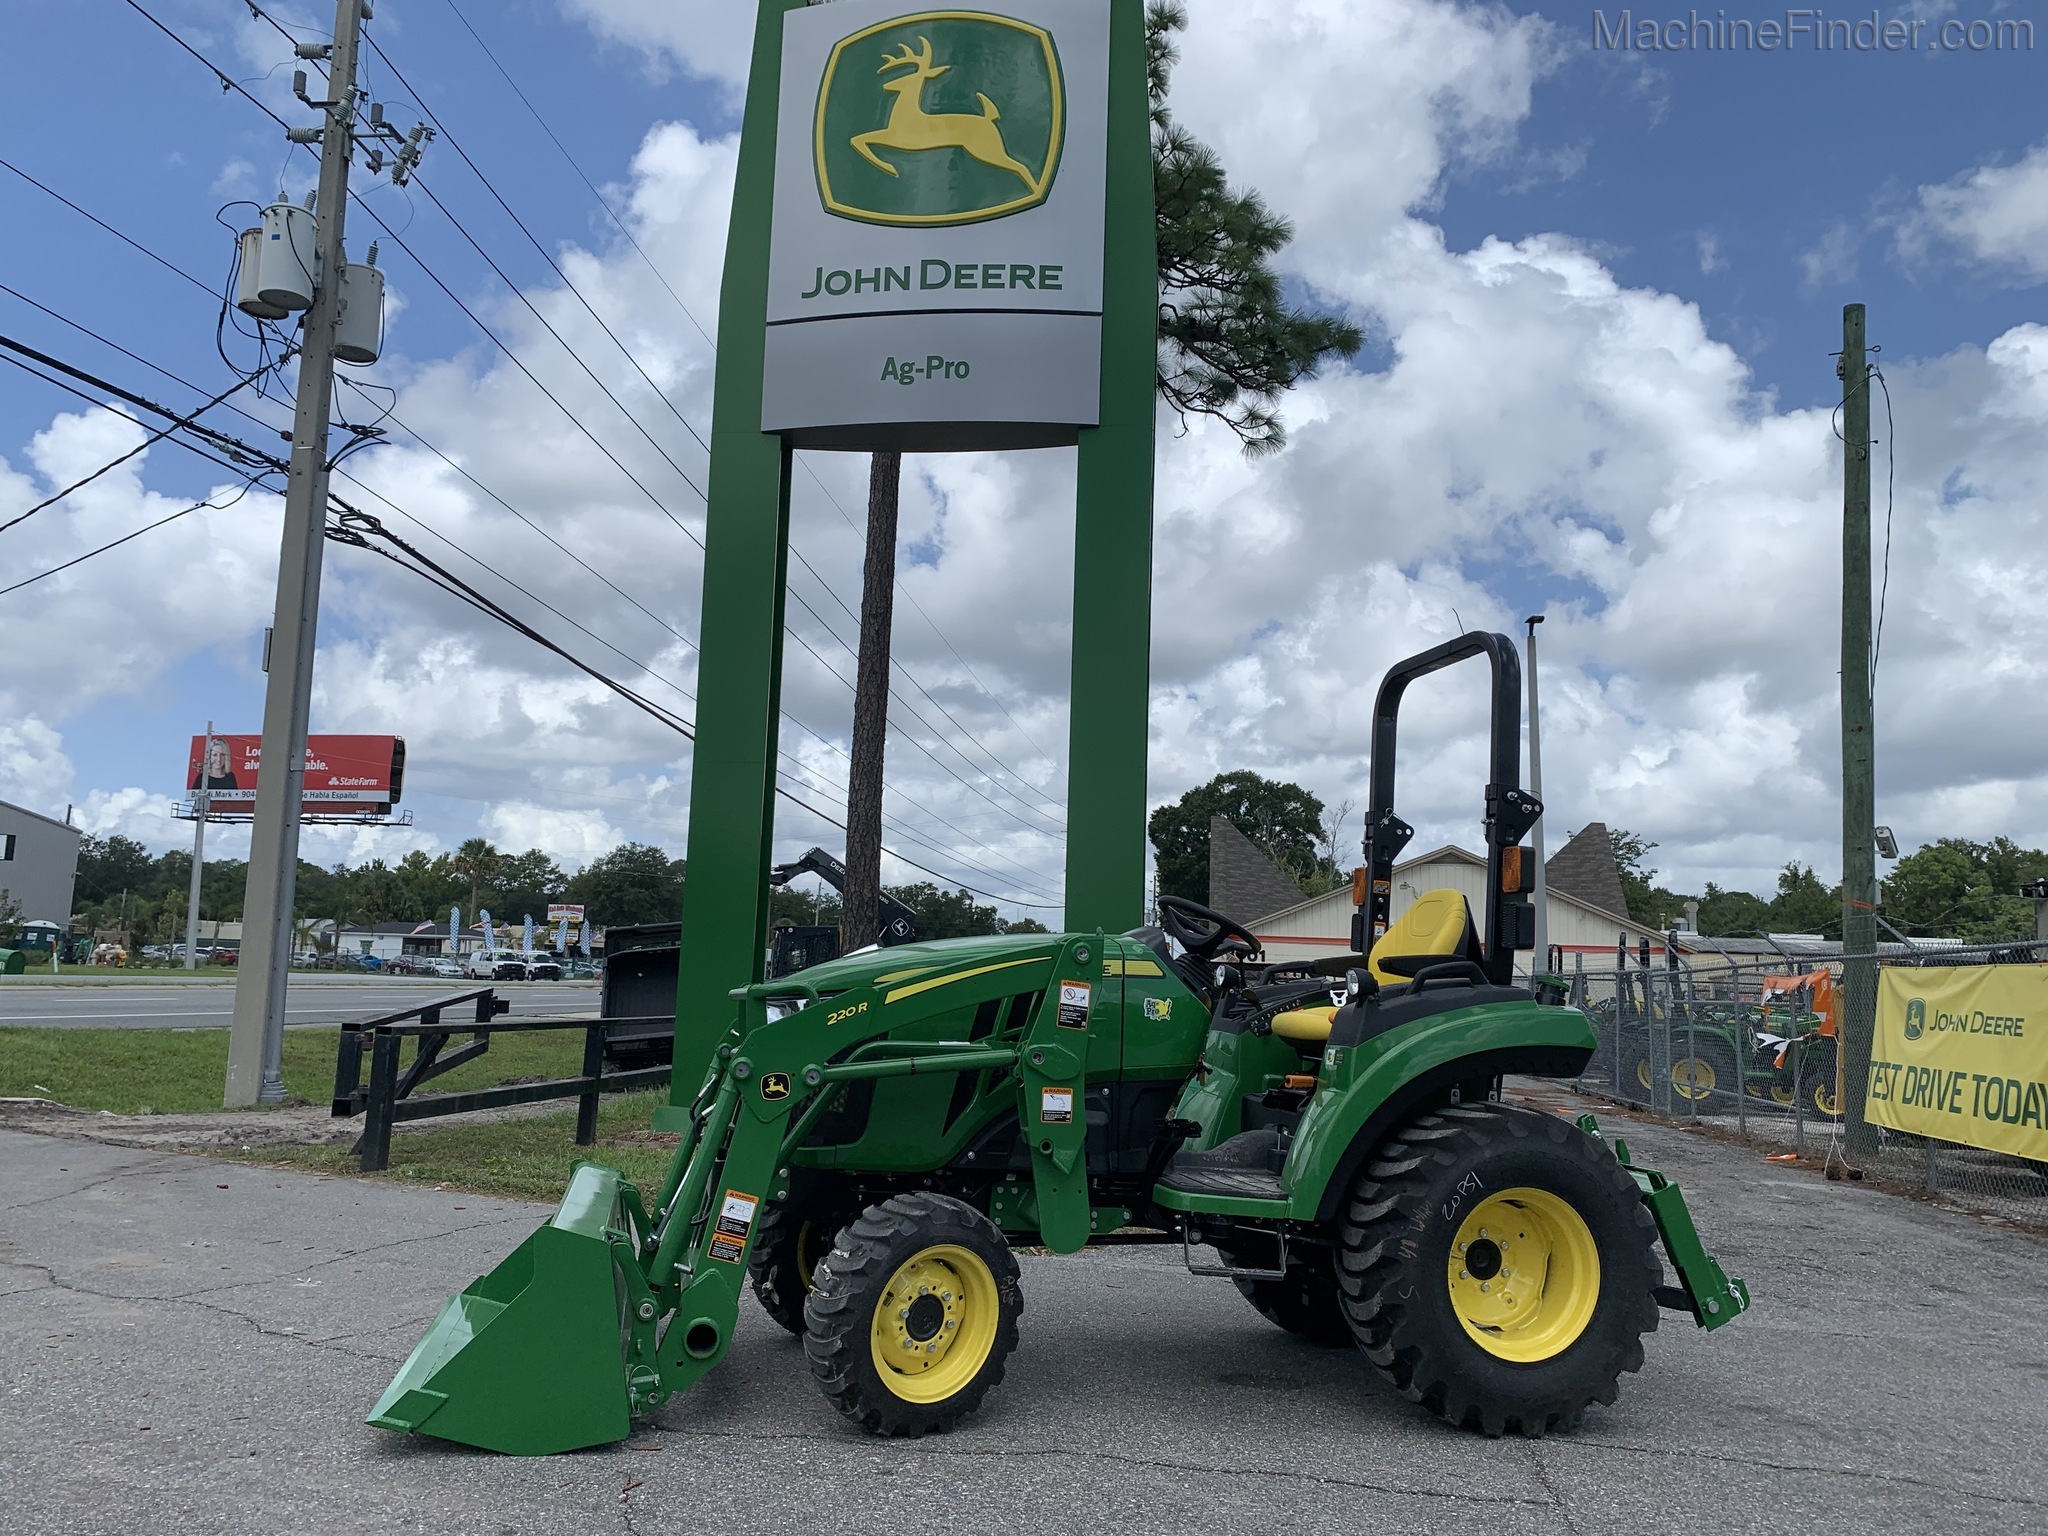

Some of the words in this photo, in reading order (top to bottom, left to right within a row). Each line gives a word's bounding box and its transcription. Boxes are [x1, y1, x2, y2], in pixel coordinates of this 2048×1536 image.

[801, 265, 911, 299] JOHN
[919, 258, 1064, 291] DEERE
[880, 355, 971, 386] Ag-Pro
[310, 791, 330, 799] Habla
[331, 792, 359, 800] Español
[1929, 1009, 1969, 1032] JOHN
[1969, 1011, 2025, 1038] DEERE
[1868, 1060, 1903, 1102] TEST
[1902, 1065, 1968, 1114] DRIVE
[734, 1193, 755, 1202] WARNING
[722, 1236, 743, 1245] WARNING
